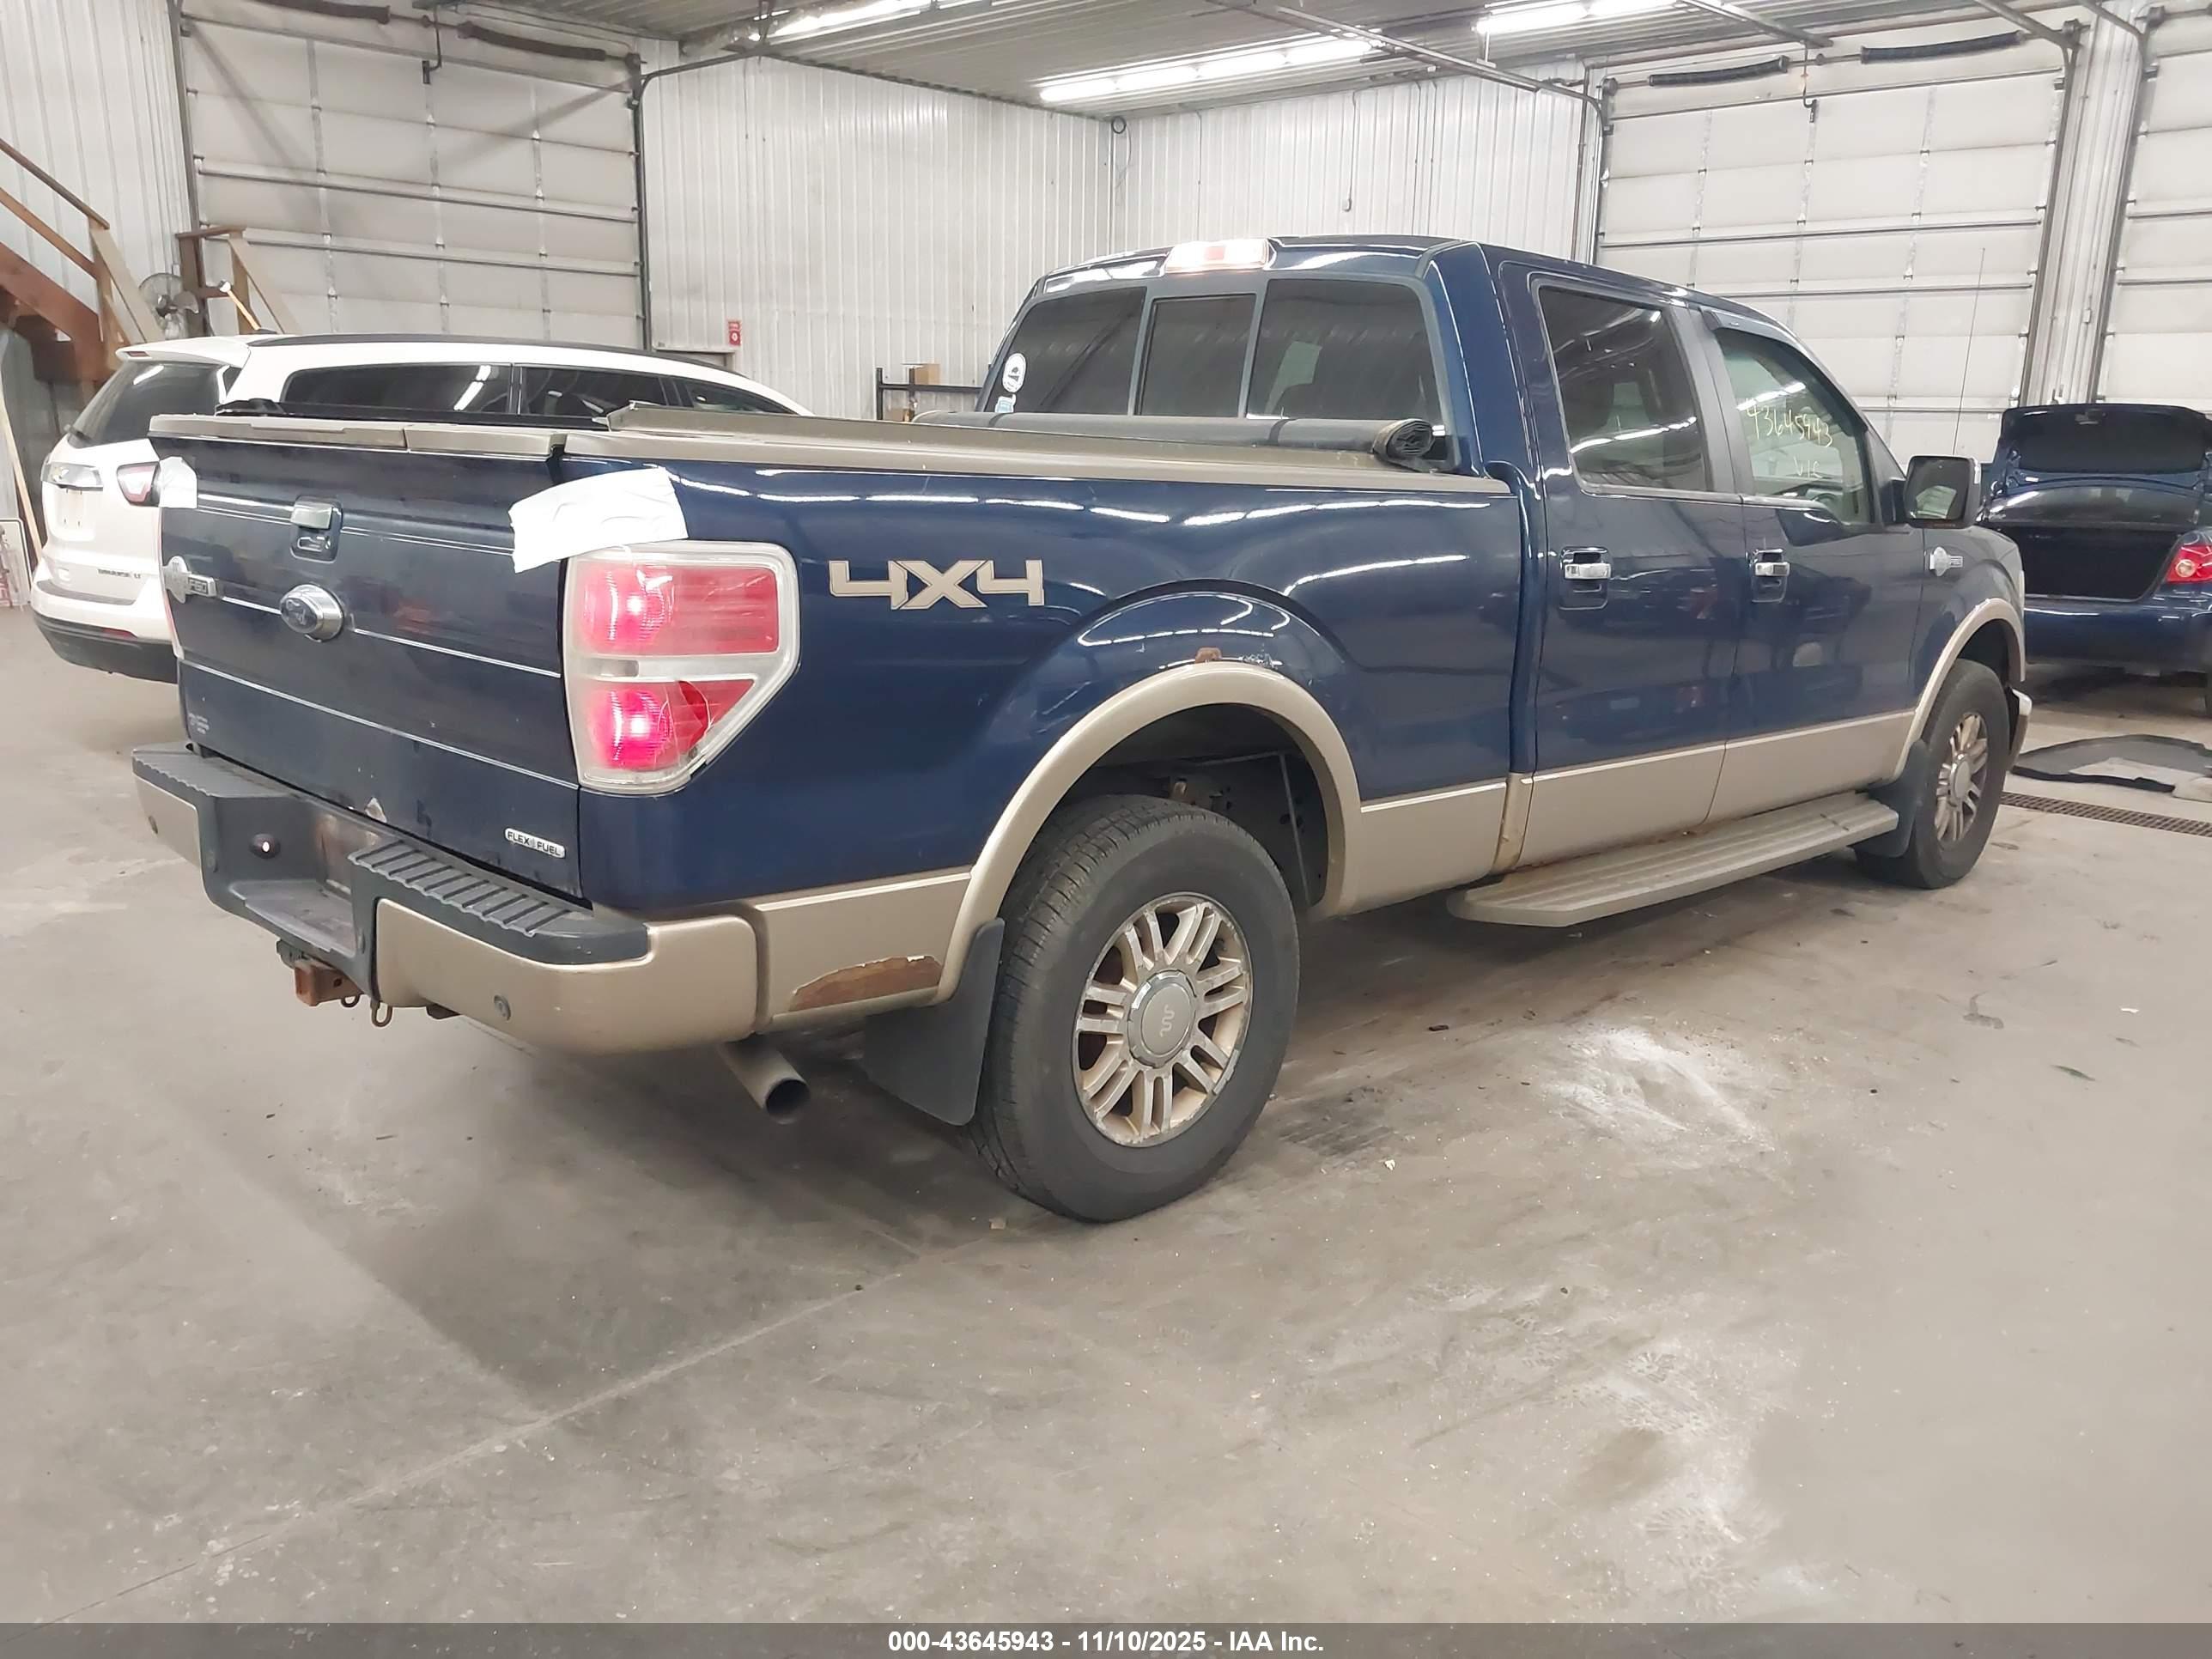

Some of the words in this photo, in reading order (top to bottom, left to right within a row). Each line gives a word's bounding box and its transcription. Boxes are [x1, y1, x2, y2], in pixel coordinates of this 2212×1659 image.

[1746, 399, 1833, 447] 43645943
[829, 560, 1045, 610] 4X4
[507, 830, 530, 846] FLEX
[537, 841, 562, 856] FUEL
